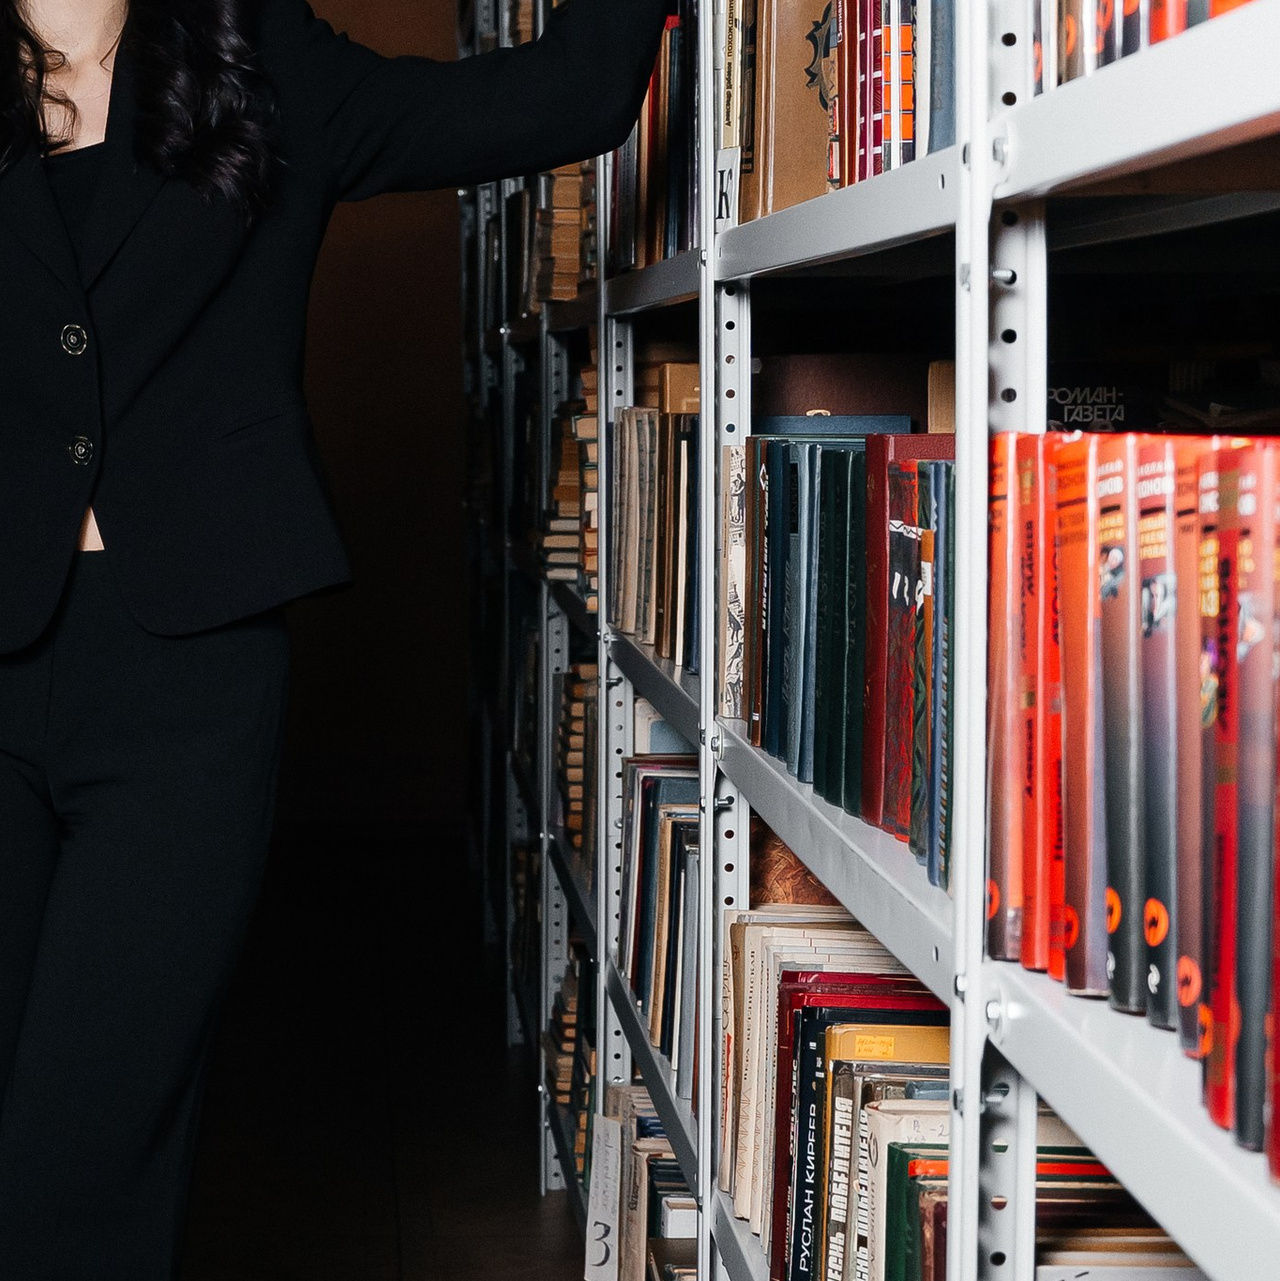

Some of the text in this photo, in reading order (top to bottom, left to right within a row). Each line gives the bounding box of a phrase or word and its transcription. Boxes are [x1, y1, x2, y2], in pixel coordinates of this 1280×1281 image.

[1064, 405, 1125, 423] ГАЗЕТА
[829, 1095, 854, 1224] ПОБЕДИТЕЛЯ
[591, 1220, 612, 1268] 3
[799, 1189, 815, 1273] РУСЛАН
